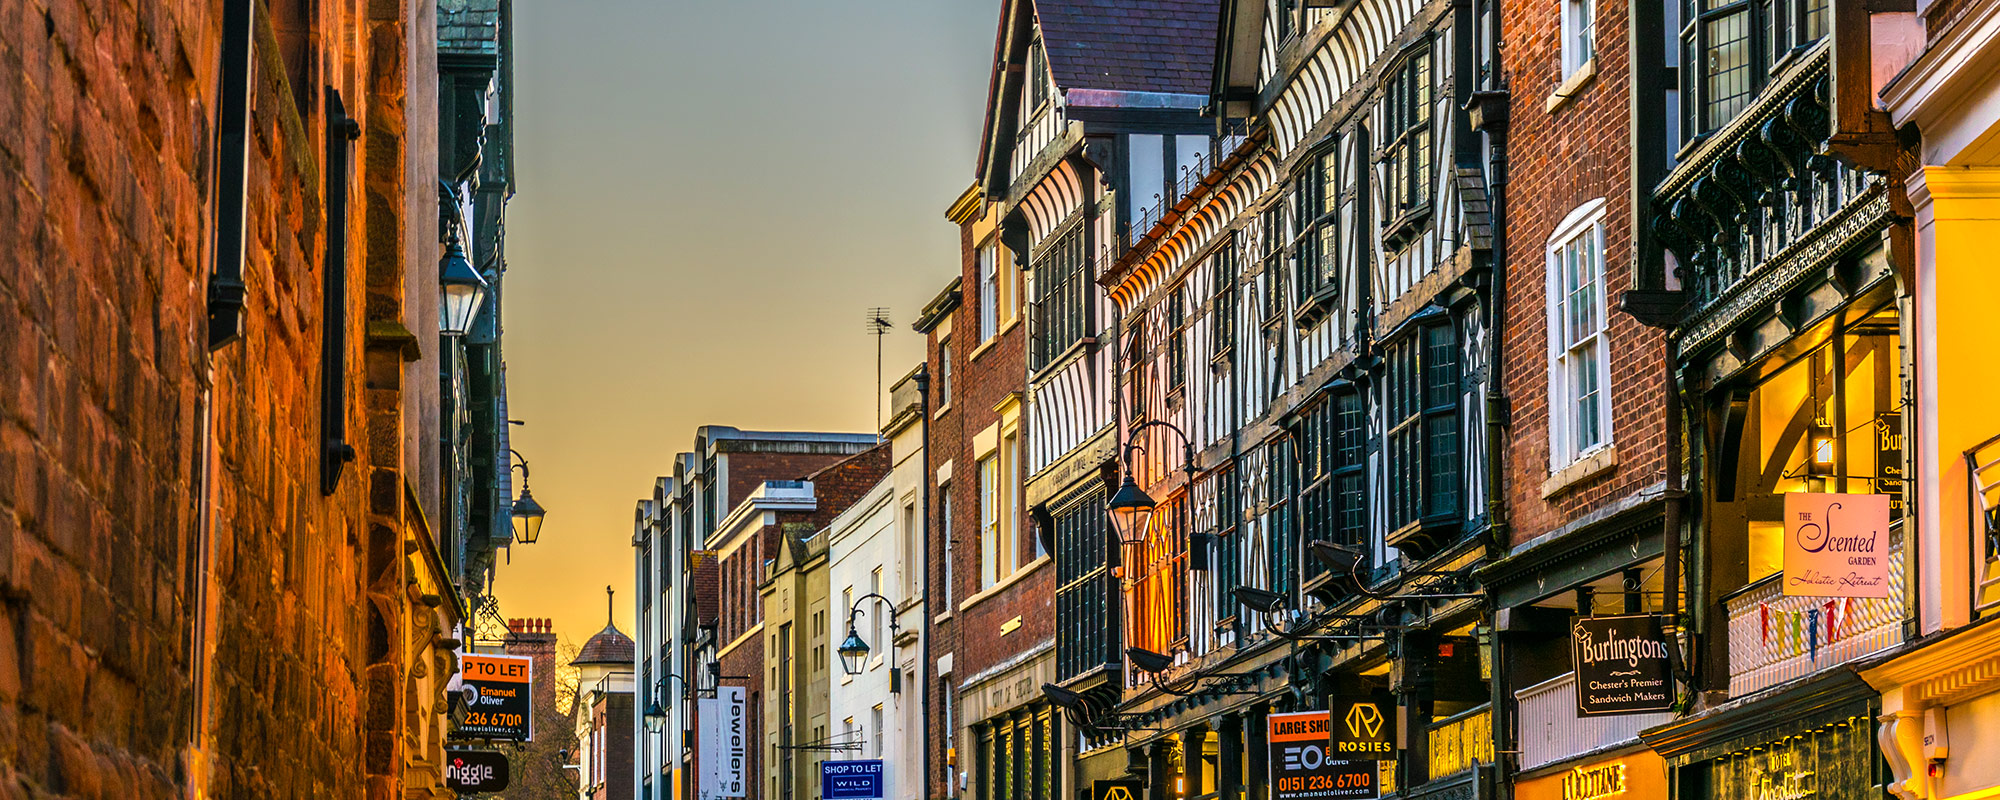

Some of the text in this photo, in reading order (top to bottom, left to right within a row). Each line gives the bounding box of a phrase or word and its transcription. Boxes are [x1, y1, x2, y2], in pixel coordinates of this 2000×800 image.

[1799, 512, 1812, 521] THE
[1796, 502, 1877, 553] Scented
[1848, 556, 1876, 566] GARDEN
[1789, 569, 1882, 591] Holistic Retreat
[1583, 628, 1668, 668] Burlingtons
[462, 661, 526, 677] P TO LET
[1589, 678, 1663, 690] Chester's Premier
[481, 686, 516, 697] Emanuel
[1589, 692, 1665, 704] Sandwich Makers
[481, 695, 504, 706] Oliver
[465, 712, 522, 726] 236 6700
[1274, 721, 1307, 735] LARGE
[731, 691, 744, 793] Jewellers
[1338, 741, 1391, 752] ROSIES
[825, 764, 882, 774] SHOP TO LET
[1279, 773, 1370, 791] 0151 236 6700
